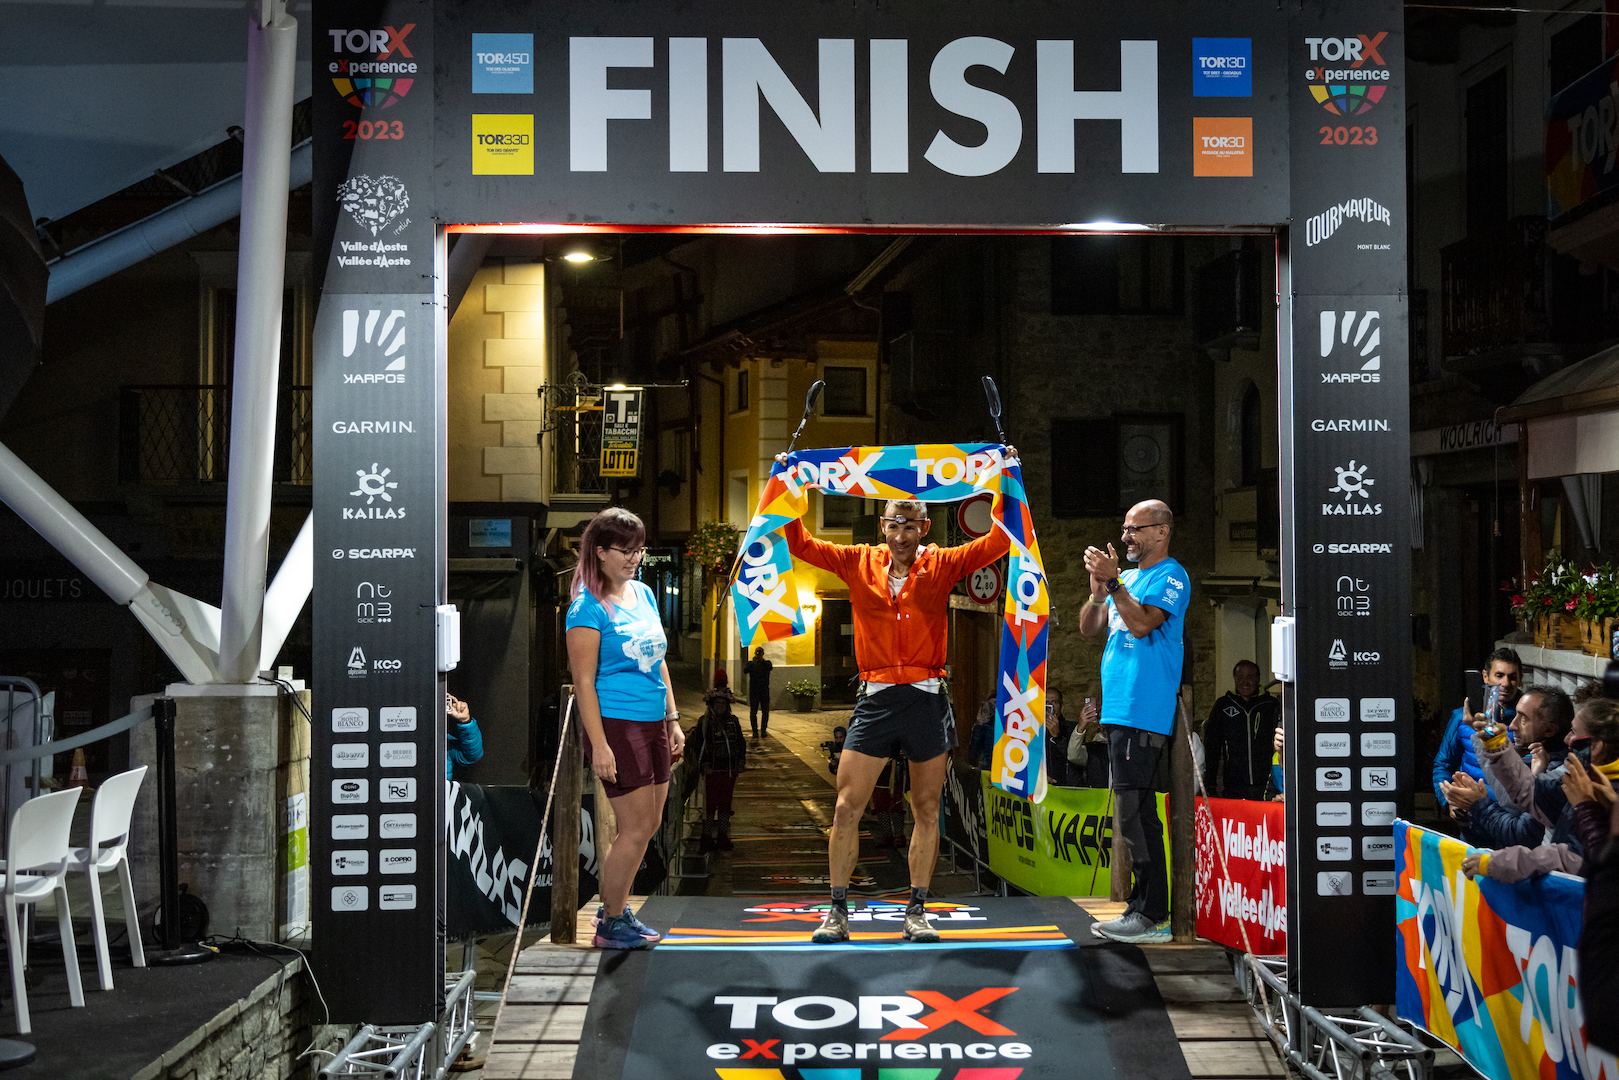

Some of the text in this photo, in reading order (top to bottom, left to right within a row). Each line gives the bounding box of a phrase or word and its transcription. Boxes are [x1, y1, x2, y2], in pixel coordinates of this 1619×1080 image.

[329, 23, 417, 60] TORX
[1304, 32, 1389, 68] TORX
[476, 53, 529, 64] TOR450
[569, 36, 1160, 175] FINISH
[343, 120, 404, 140] 2023
[477, 134, 529, 145] TOR330
[1202, 136, 1244, 147] TOR30
[1319, 126, 1379, 146] 2023
[1306, 197, 1391, 247] COURMAYEUR
[340, 240, 369, 253] Valle
[337, 254, 372, 268] Vallée
[610, 393, 635, 423] T
[332, 421, 413, 434] GARMIN
[1311, 419, 1388, 432] GARMIN
[602, 450, 636, 469] LOTTO
[777, 452, 884, 499] TORX
[343, 507, 407, 520] KAILAS
[1322, 503, 1382, 516] KAILAS
[737, 516, 798, 630] ORX
[1001, 670, 1040, 791] TORX
[1222, 817, 1252, 866] Valle
[1217, 877, 1258, 927] Vallée
[713, 987, 1020, 1041] TORX
[705, 1039, 1033, 1065] eXperience
